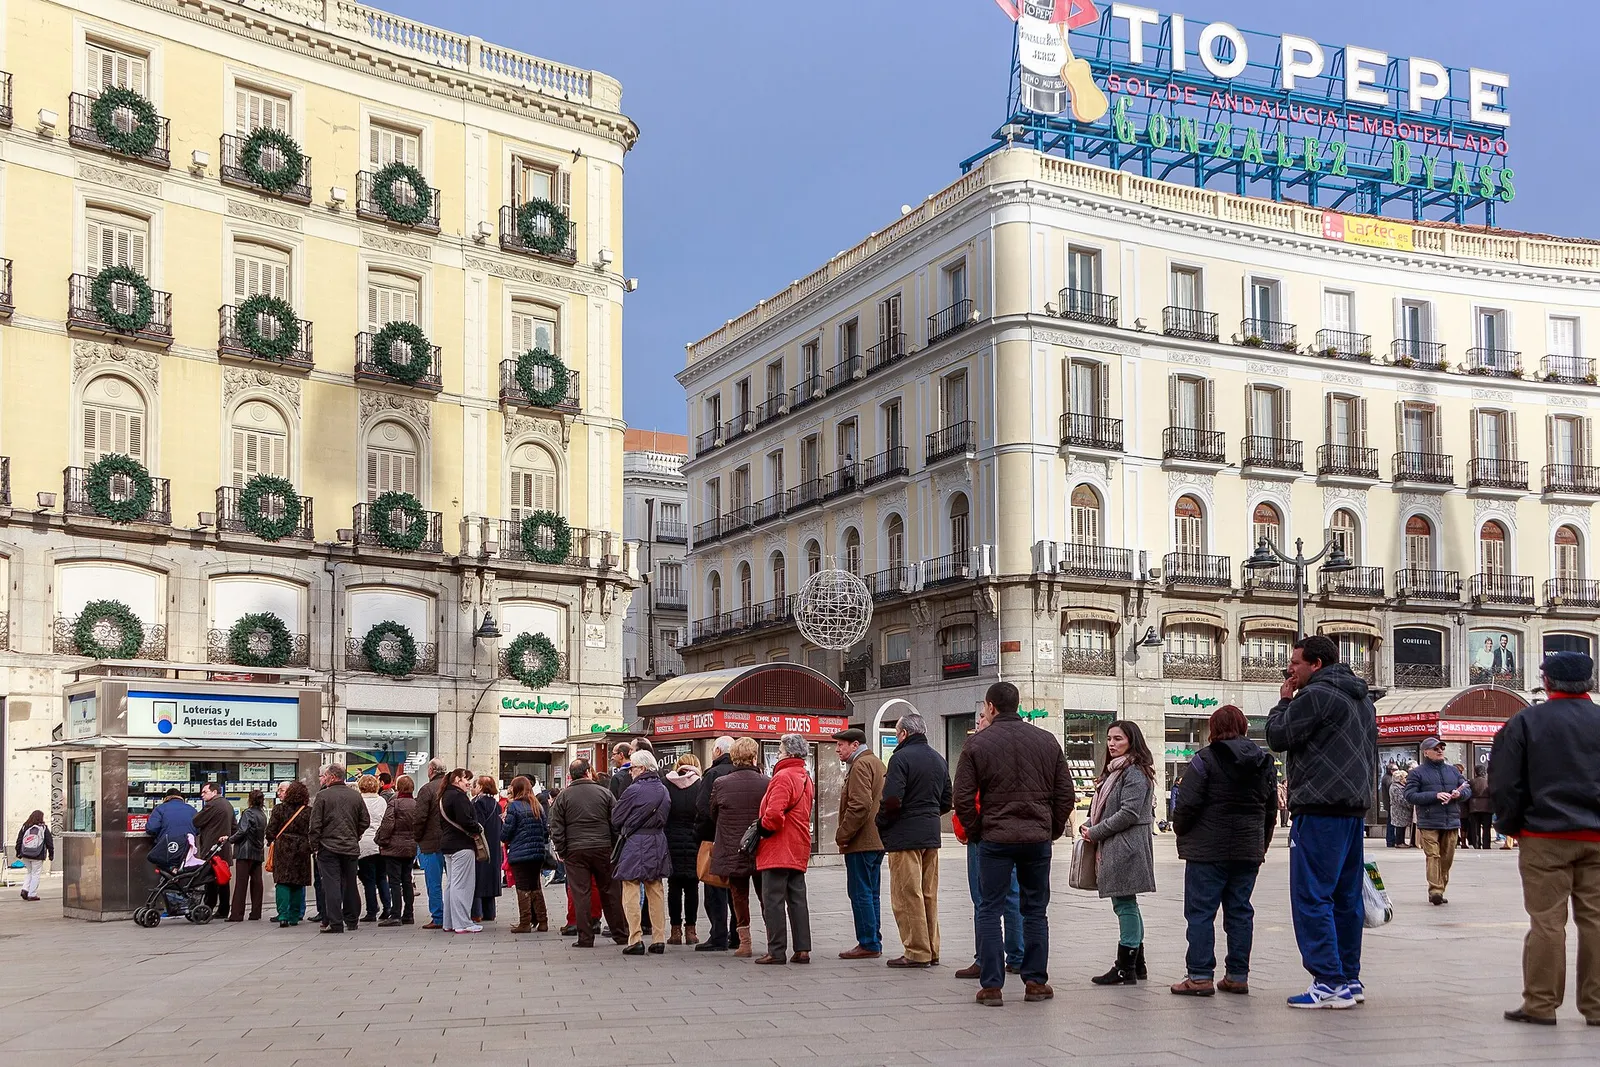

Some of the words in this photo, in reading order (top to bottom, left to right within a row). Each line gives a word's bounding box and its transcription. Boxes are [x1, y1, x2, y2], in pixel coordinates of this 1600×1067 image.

[1032, 50, 1056, 62] JEREZ
[1112, 2, 1248, 79] TIO
[1281, 34, 1511, 127] PEPE
[1107, 74, 1158, 99] SOL
[1167, 83, 1198, 105] DE
[1208, 91, 1339, 127] ANDALUCIA
[1347, 114, 1509, 156] EMBOTELLADO
[1113, 95, 1348, 176] GONZALEZ
[1391, 139, 1515, 202] BYASS
[1402, 637, 1431, 645] CORTEFIEL
[183, 705, 222, 714] Loterías
[224, 707, 230, 717] y
[502, 697, 512, 709] El
[512, 697, 535, 710] Corte
[536, 696, 569, 714] Inglés
[183, 717, 227, 727] Apuestas
[229, 718, 243, 727] del
[246, 718, 278, 727] Estado
[692, 713, 714, 729] TICKETS
[785, 718, 811, 732] TICKETS
[1399, 723, 1426, 732] TURÍSTICO
[1450, 723, 1461, 731] BUS
[1461, 722, 1488, 732] TURÍSTICO
[658, 754, 680, 769] OUIJ
